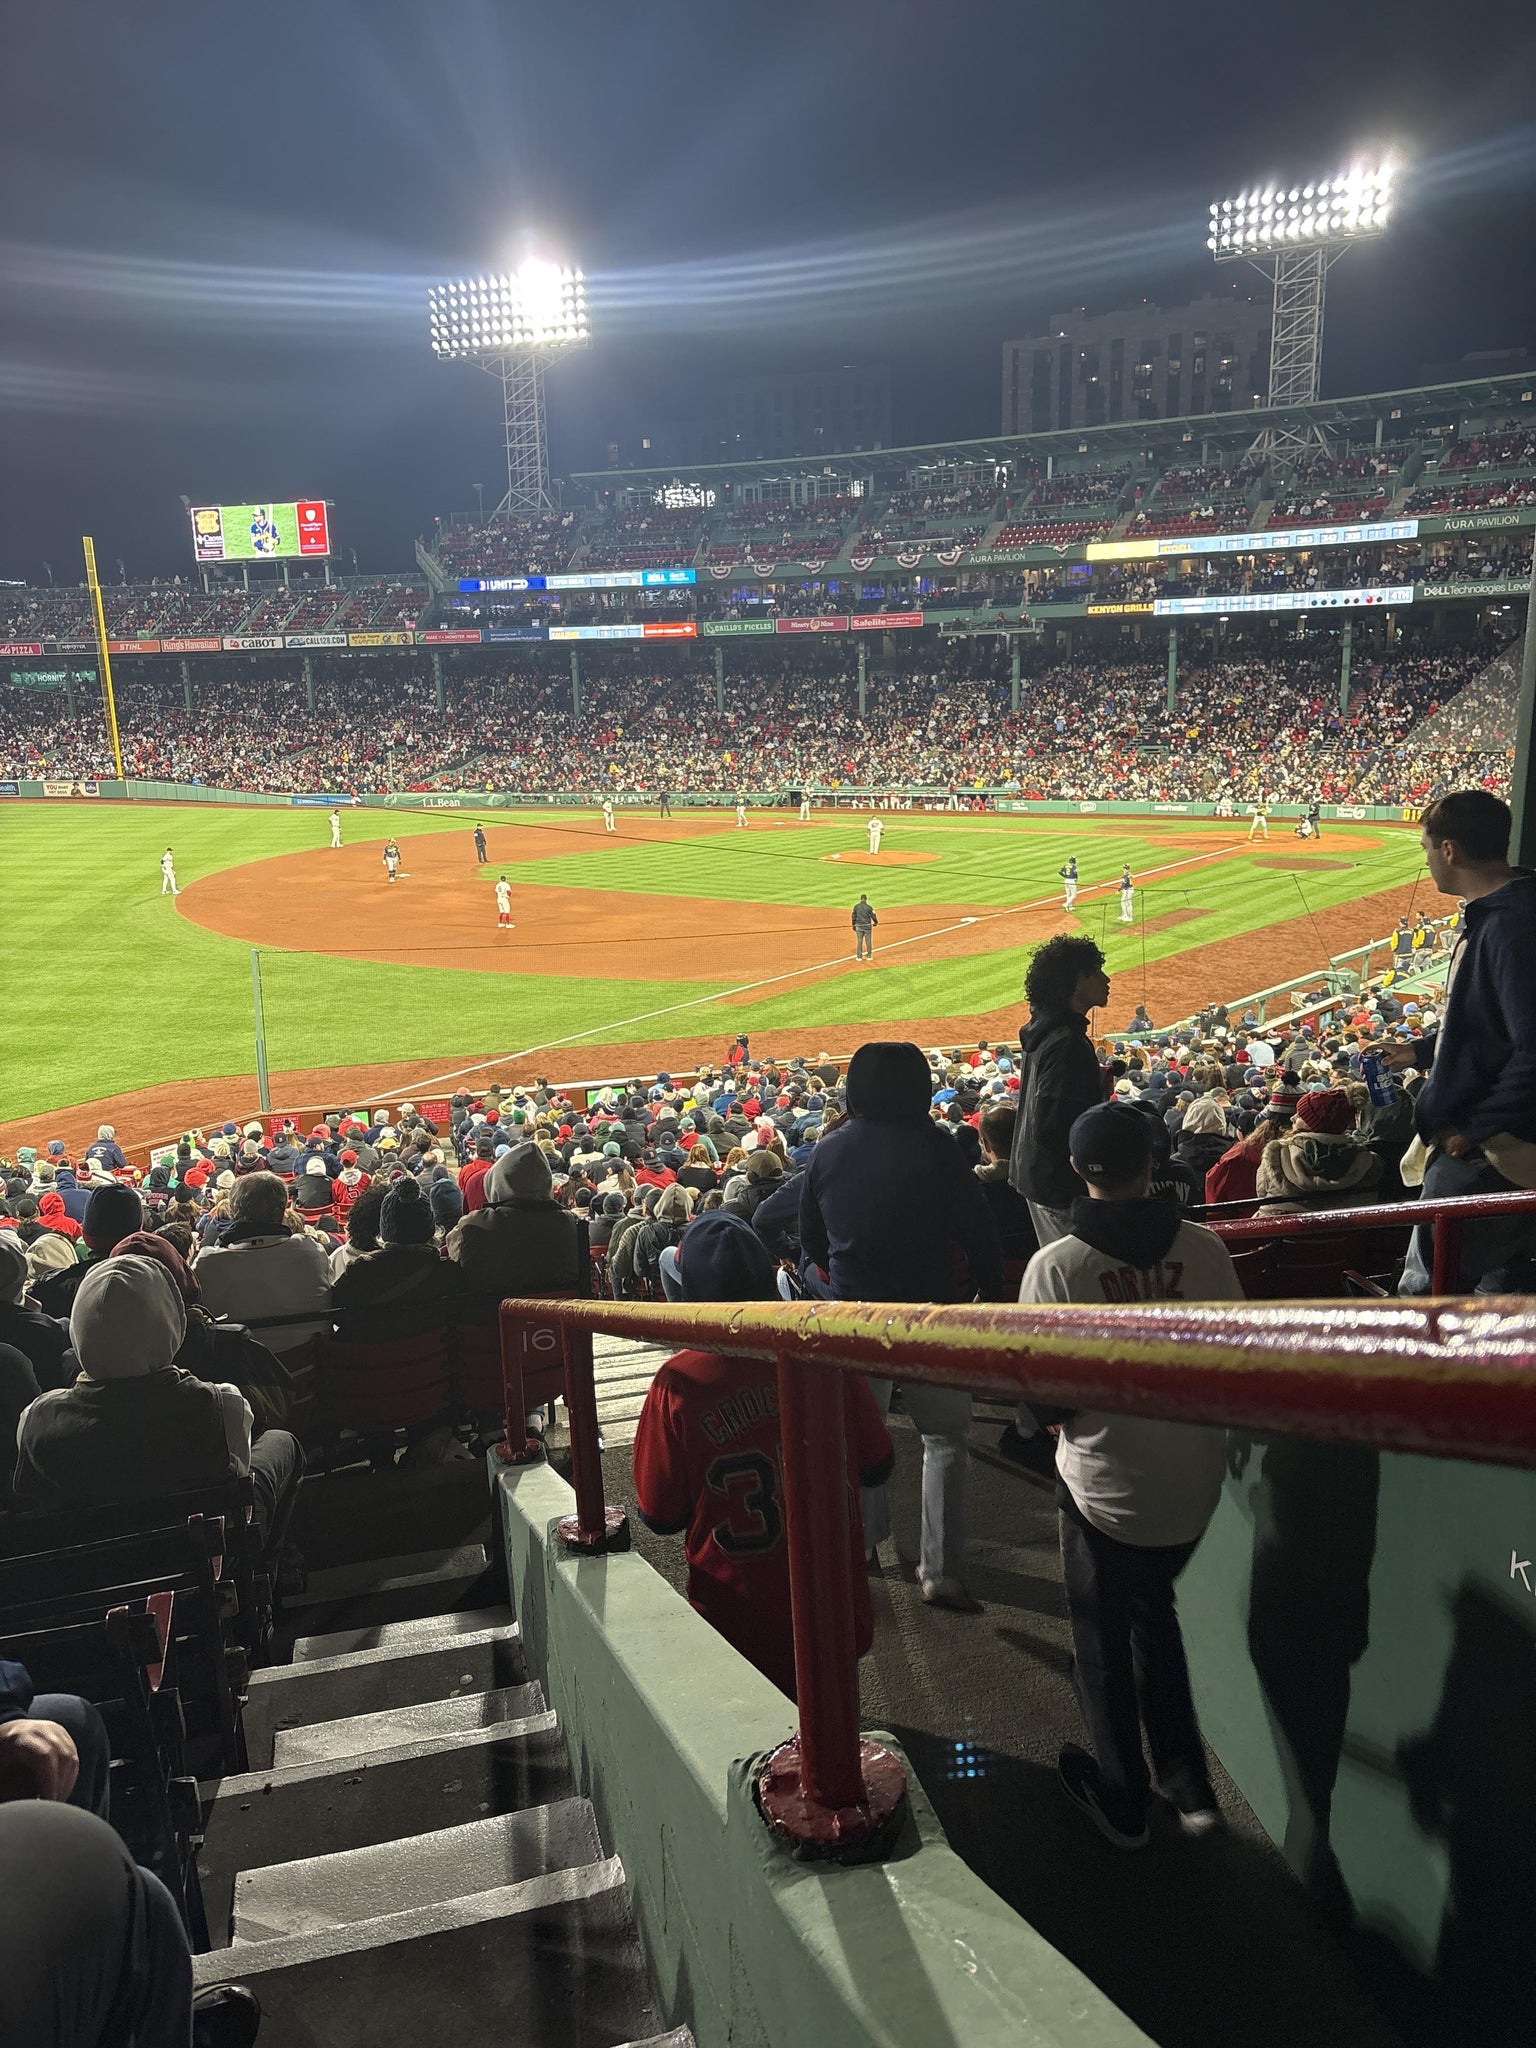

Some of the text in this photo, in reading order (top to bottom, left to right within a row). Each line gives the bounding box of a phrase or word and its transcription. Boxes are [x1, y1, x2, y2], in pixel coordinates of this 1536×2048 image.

[1476, 515, 1520, 527] PAVILION
[993, 552, 1026, 563] PAVILION
[489, 579, 529, 591] UNITED
[1423, 586, 1450, 597] DELL
[1450, 584, 1506, 596] Technologies
[1087, 604, 1123, 614] KENYON
[1123, 602, 1154, 613] GRILLS
[714, 622, 772, 633] GRILLO'S PICKLES
[790, 621, 835, 631] Ninety Nine
[853, 617, 886, 628] Safelite
[11, 645, 34, 655] PIZZA
[119, 643, 143, 652] STIHL
[163, 639, 218, 651] King's Hawaiian
[1376, 1071, 1392, 1083] BU
[522, 1328, 556, 1353] 16
[701, 1382, 779, 1450] CROC
[705, 1449, 784, 1558] 3
[1510, 1549, 1536, 1598] K
